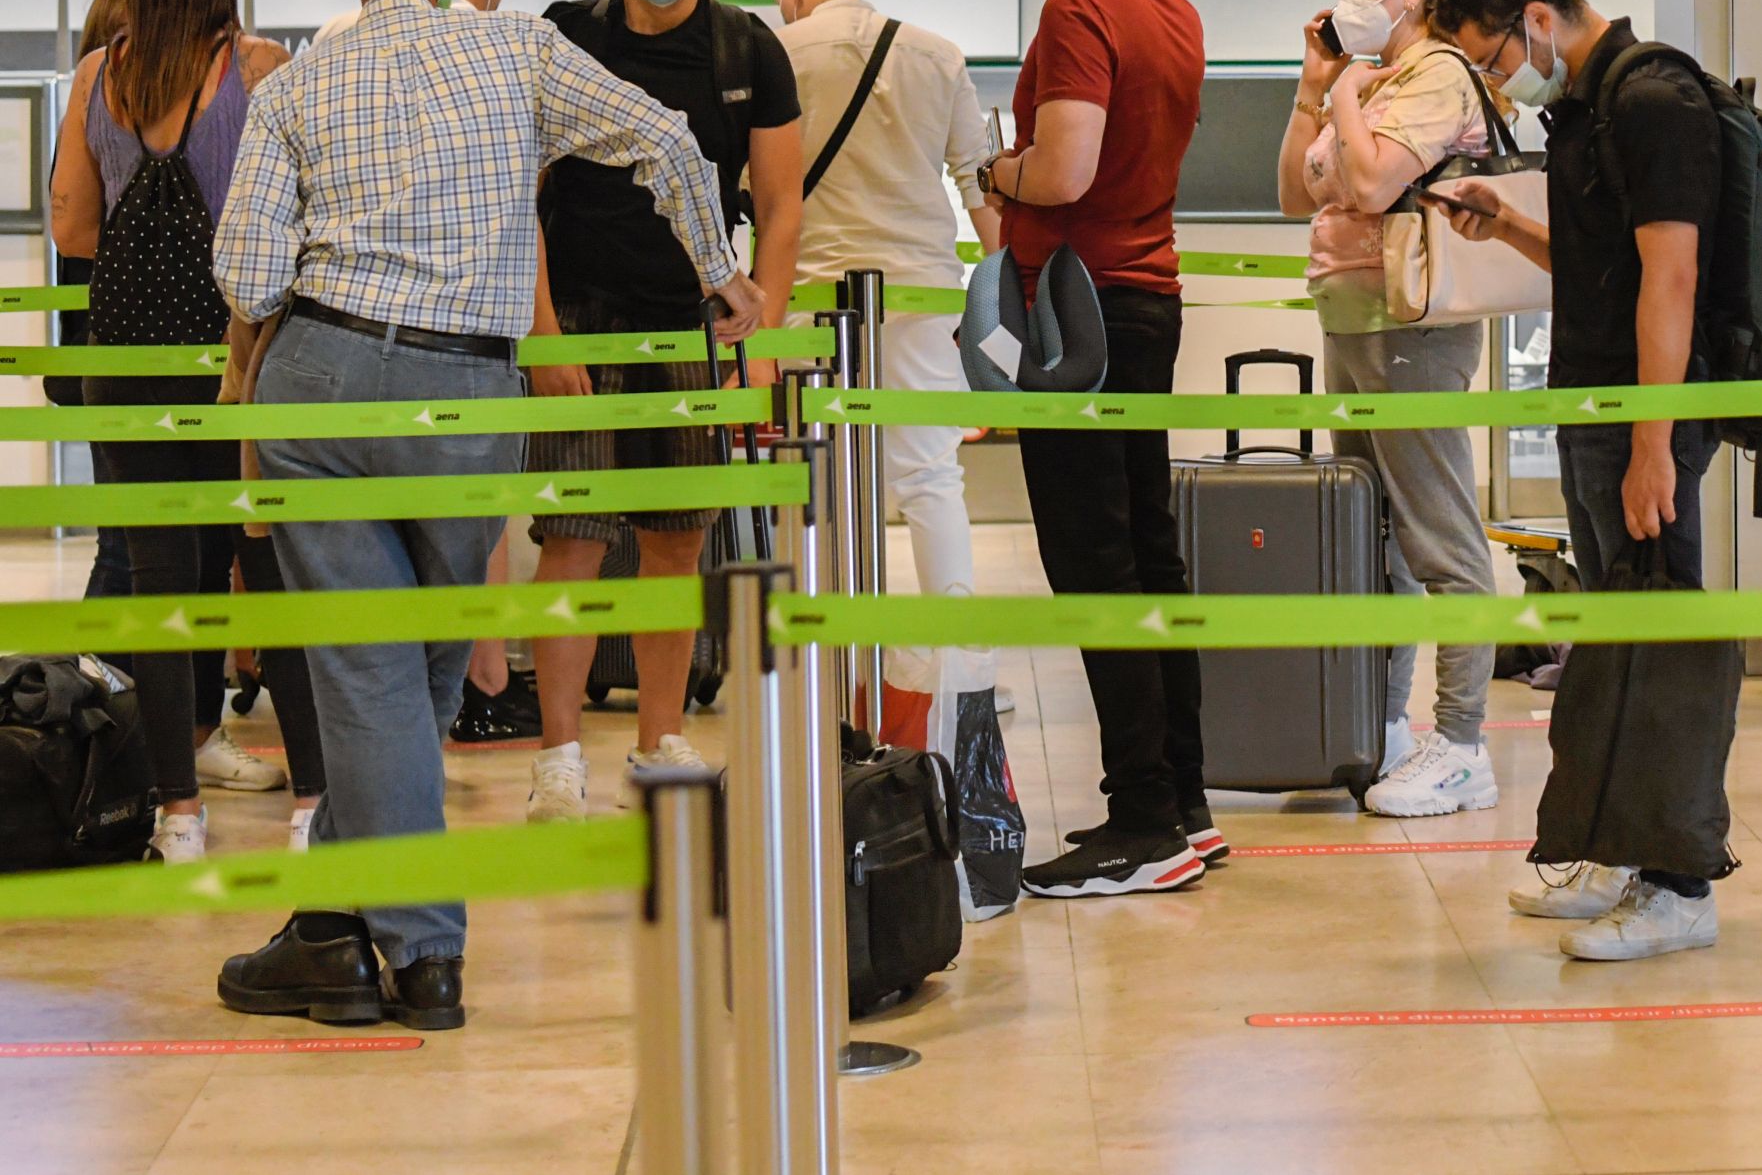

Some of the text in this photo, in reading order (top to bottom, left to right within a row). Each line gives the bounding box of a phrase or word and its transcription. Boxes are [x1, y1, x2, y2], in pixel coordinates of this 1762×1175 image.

[3, 296, 21, 304] aena
[654, 342, 676, 352] aena
[692, 402, 717, 412] aena
[846, 402, 871, 412] aena
[1598, 400, 1622, 410] aena
[1100, 406, 1125, 415] aena
[1351, 406, 1375, 416] aena
[177, 417, 202, 427] aena
[435, 412, 460, 422] aena
[561, 486, 591, 497] aena
[255, 496, 285, 506] aena
[100, 806, 131, 825] Reebok
[1097, 857, 1128, 869] NAUTICA
[1407, 1013, 1523, 1021] distancia
[1543, 1011, 1602, 1020] Keep
[1610, 1009, 1665, 1019] your
[164, 1043, 226, 1052] Keep
[234, 1042, 287, 1052] your
[296, 1041, 402, 1050] distance
